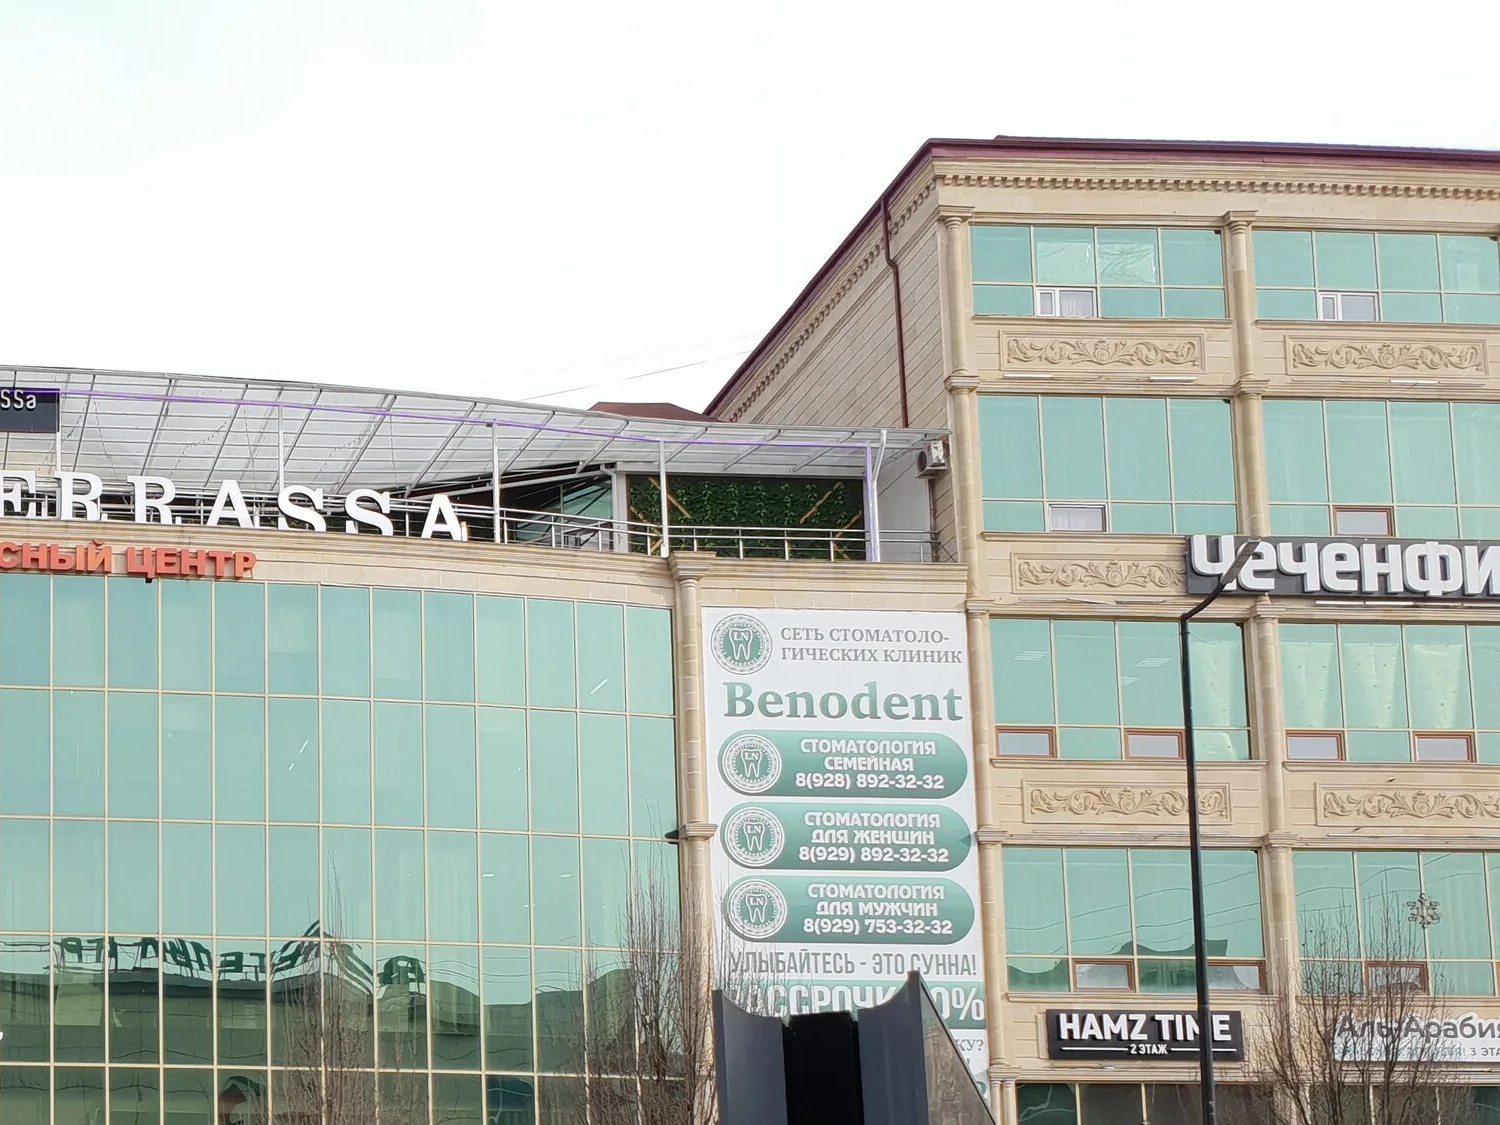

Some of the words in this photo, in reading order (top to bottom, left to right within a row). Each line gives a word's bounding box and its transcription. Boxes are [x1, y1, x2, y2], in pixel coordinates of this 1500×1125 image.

[126, 546, 259, 581] ЦЕНТР
[780, 627, 824, 642] СЕТЬ
[829, 628, 949, 644] СТОМАТОЛО-
[780, 647, 879, 662] ГИЧЕСКИХ
[884, 648, 963, 664] КЛИНИК
[722, 681, 964, 721] Benodent
[800, 738, 937, 755] СТОМАТОЛОГИЯ
[824, 755, 915, 772] СЕМЕЙНАЯ
[795, 773, 851, 790] 8(928)
[856, 774, 945, 790] 892-32-32
[804, 812, 941, 828] СТОМАТОЛОГИЯ
[811, 829, 849, 845] ДЛЯ
[853, 829, 935, 847] ЖЕНЩИН
[798, 846, 856, 863] 8(929)
[860, 847, 949, 864] 892-32-32
[807, 884, 945, 900] СТОМАТОЛОГИЯ
[816, 901, 853, 917] ДЛЯ
[858, 901, 939, 918] МУЖЧИН
[803, 918, 860, 936] 8(929)
[866, 919, 953, 936] 753-32-32
[730, 949, 855, 974] УЛЫБАЙТЕСЬ
[872, 953, 905, 974] ЭТО
[910, 952, 977, 977] СУННА!
[1058, 1013, 1148, 1041] HAMZ
[1130, 1044, 1138, 1054] 2
[1139, 1044, 1168, 1055] ЭТАЖ
